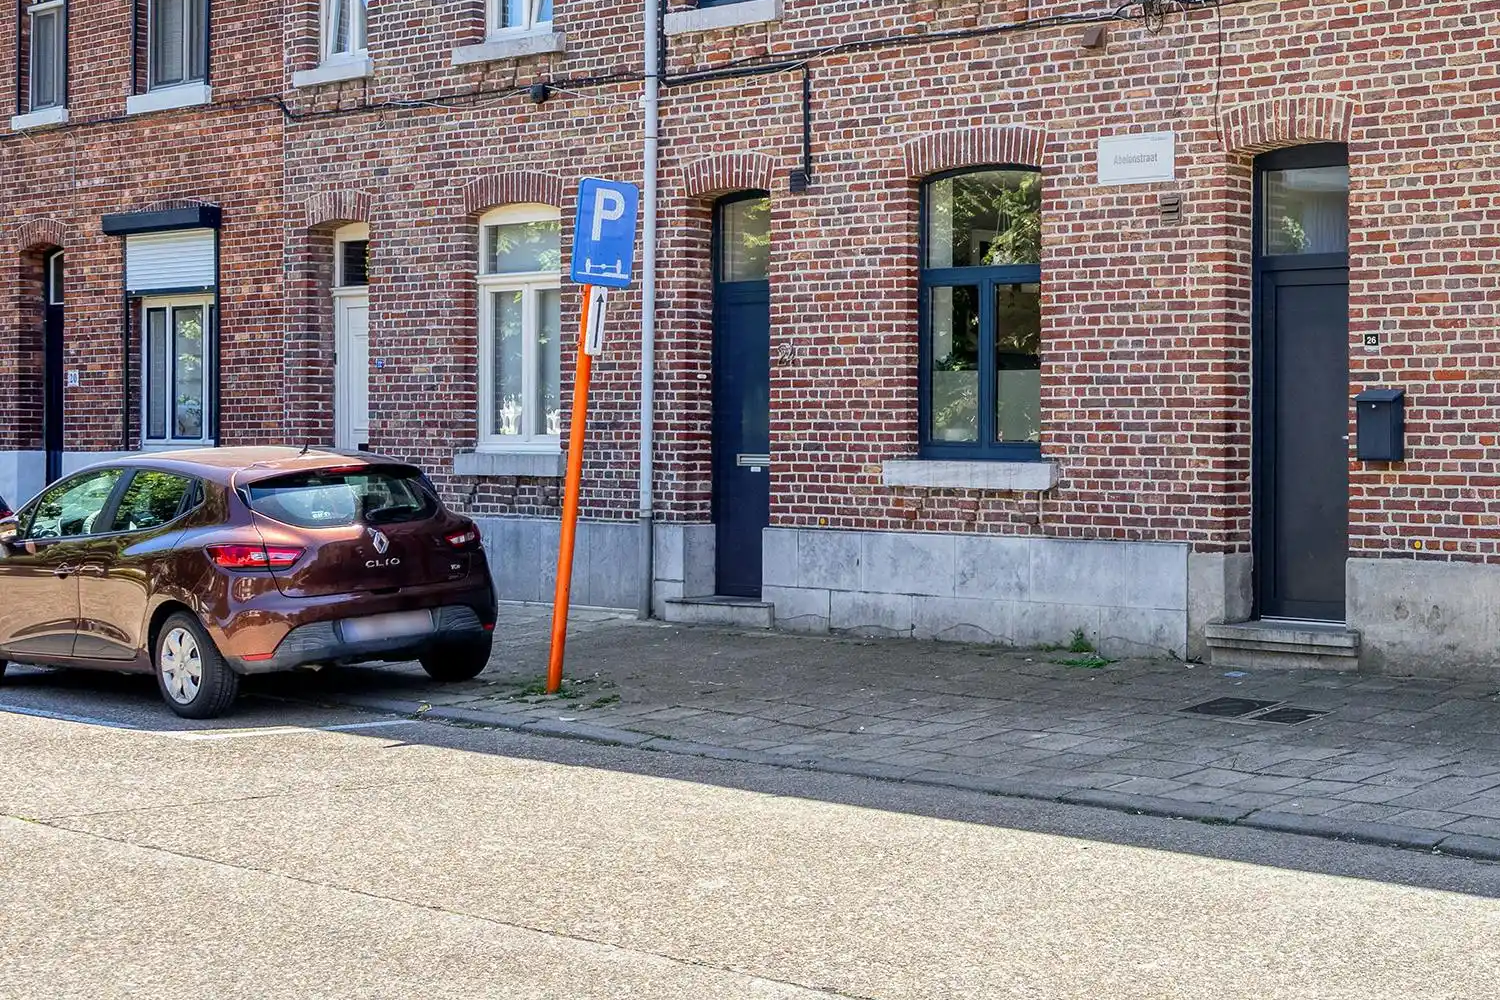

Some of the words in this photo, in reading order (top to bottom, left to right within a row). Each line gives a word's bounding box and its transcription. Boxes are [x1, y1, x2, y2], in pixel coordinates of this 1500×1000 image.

[591, 187, 626, 241] P
[1366, 336, 1377, 345] 26
[365, 557, 401, 569] CLIO
